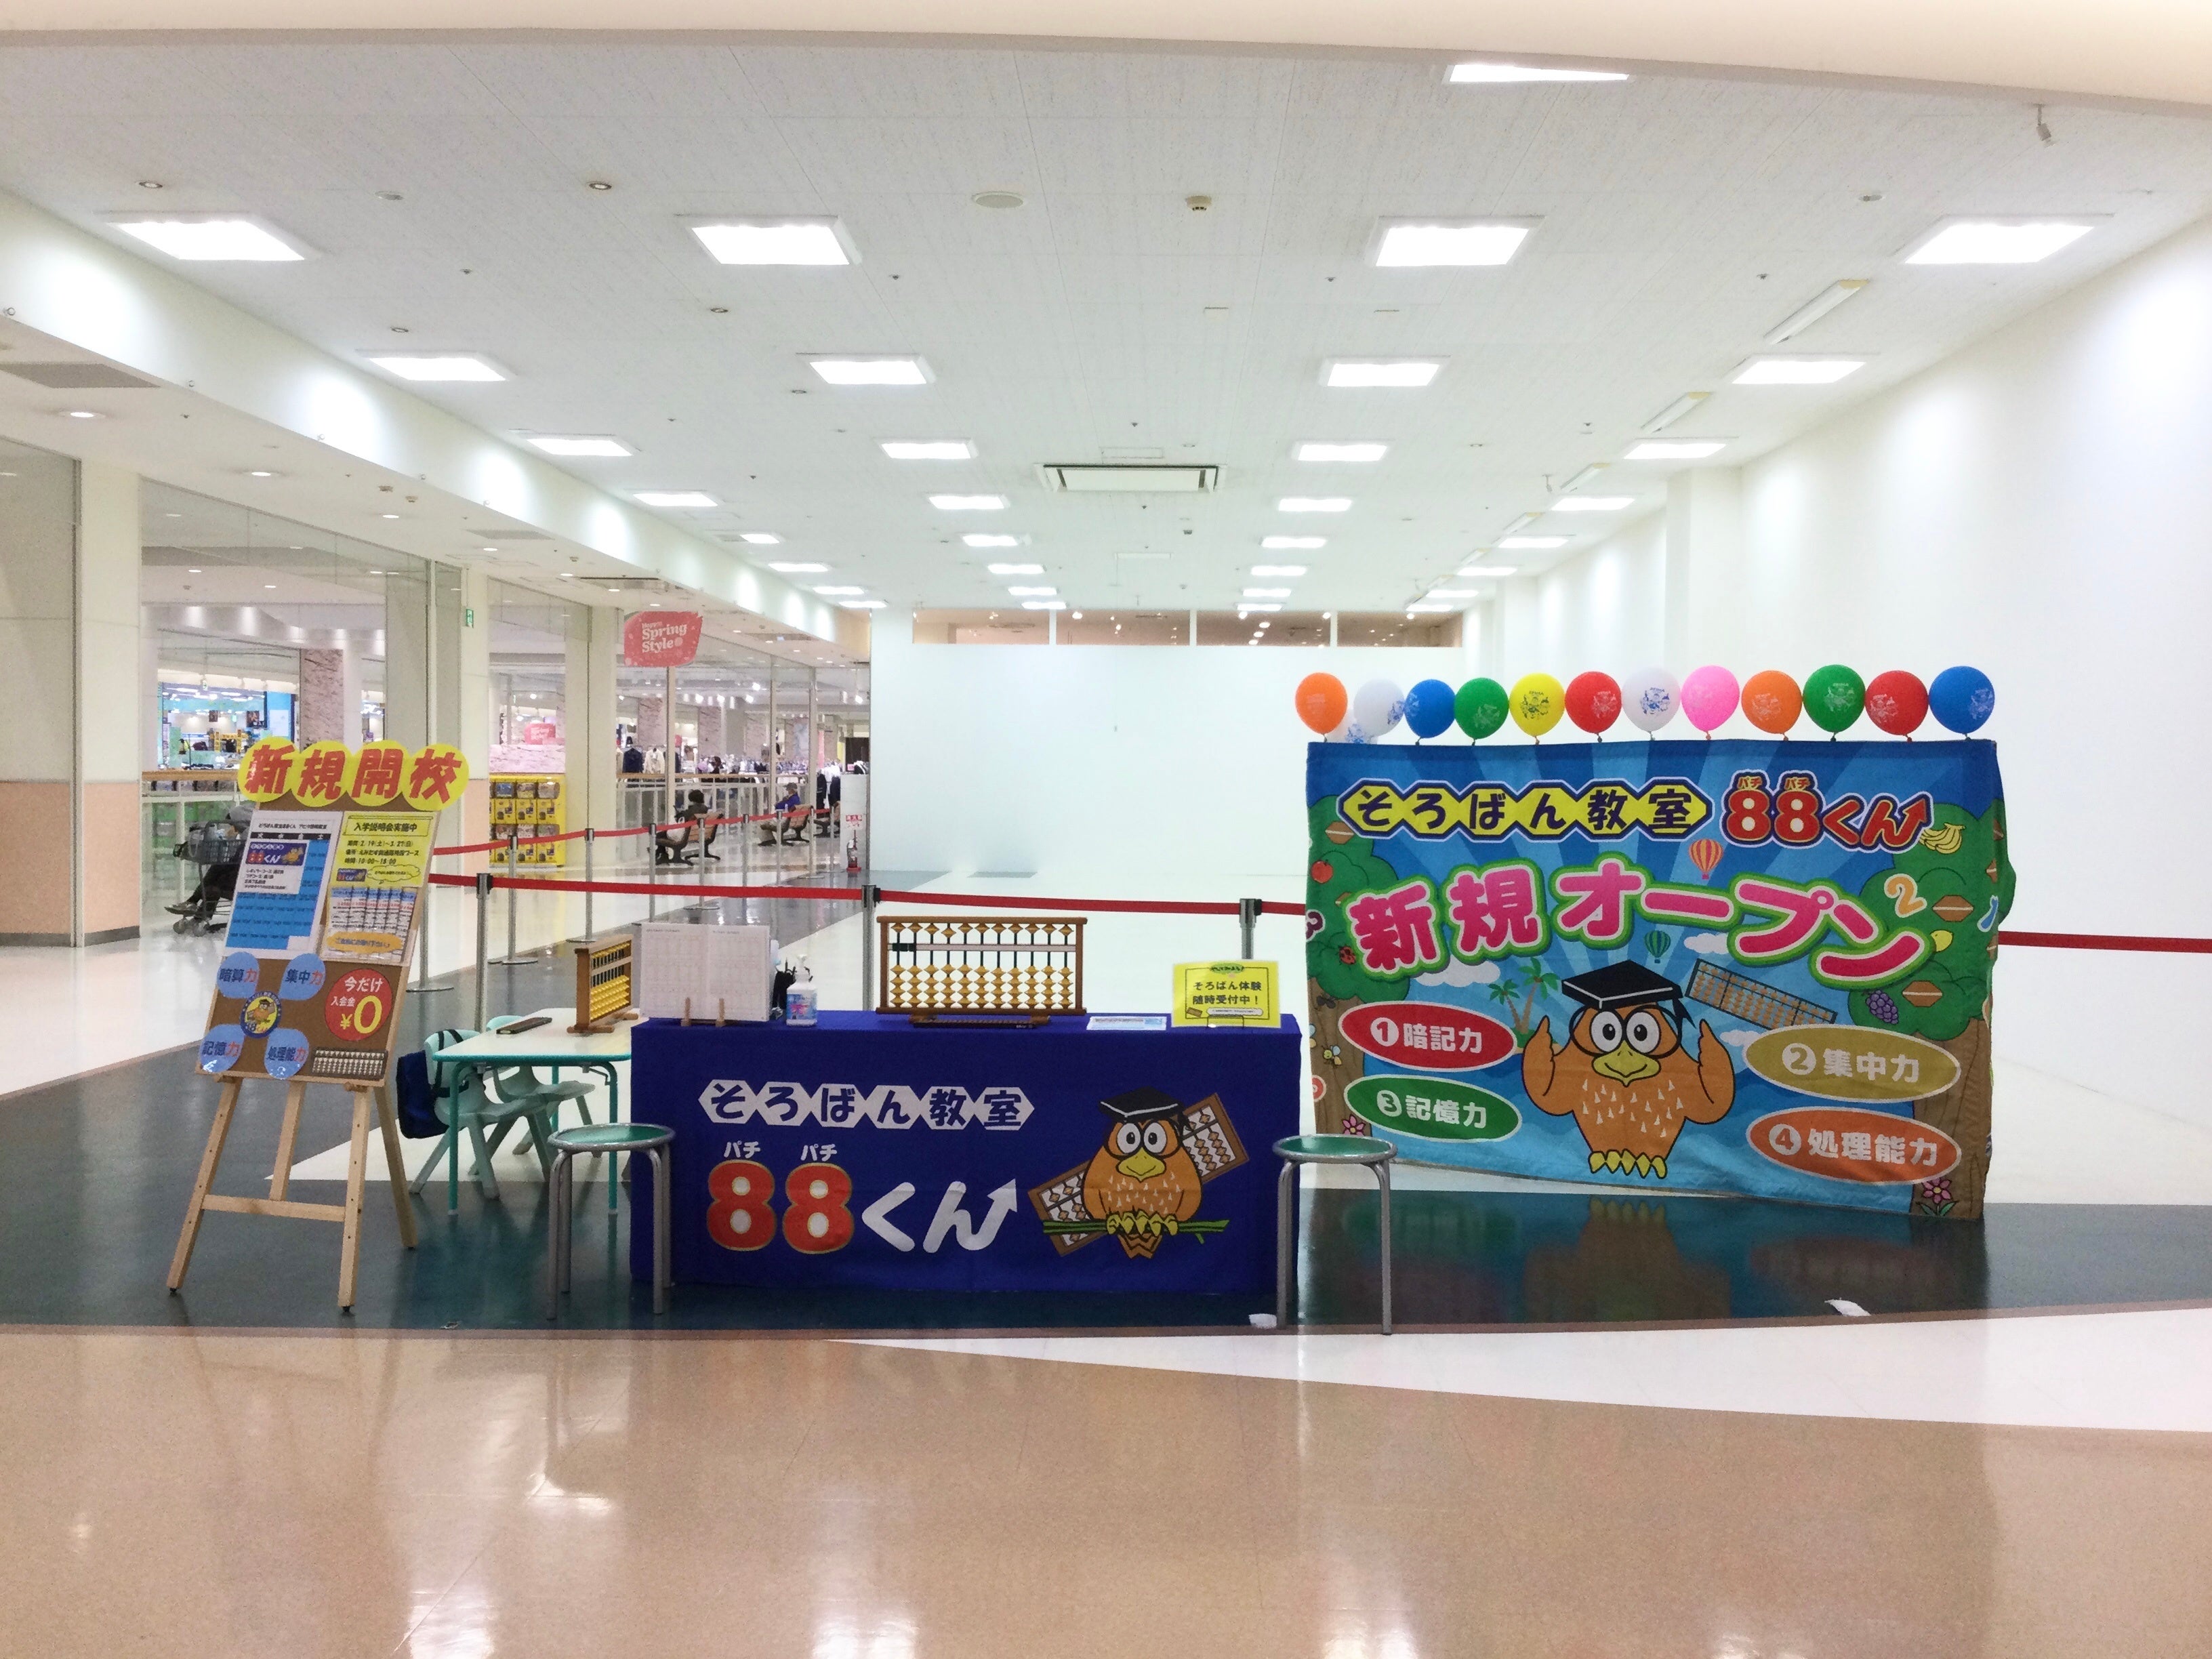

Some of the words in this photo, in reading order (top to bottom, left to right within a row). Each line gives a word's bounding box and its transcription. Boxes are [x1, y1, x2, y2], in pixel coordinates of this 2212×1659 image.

[642, 624, 687, 640] Spring
[642, 638, 674, 653] Style
[245, 744, 462, 803] 新規開校
[1737, 776, 1763, 790] パチ
[1784, 777, 1810, 790] パチ
[1357, 788, 1692, 834] そろばん教室
[1727, 789, 1929, 846] 88くん
[1349, 861, 1921, 978] 新規オープン
[219, 968, 258, 983] 暗算力
[287, 968, 322, 985] 集中力
[344, 976, 383, 993] 今だけ
[1193, 981, 1262, 991] そろばん体験
[331, 997, 355, 1007] 入会金
[201, 1041, 240, 1057] 記憶力
[266, 1046, 305, 1062] 処理能力
[710, 1083, 1021, 1128] そろばん教室
[723, 1141, 760, 1159] パチ
[800, 1143, 838, 1162] パチ
[706, 1160, 1017, 1254] 88くん
